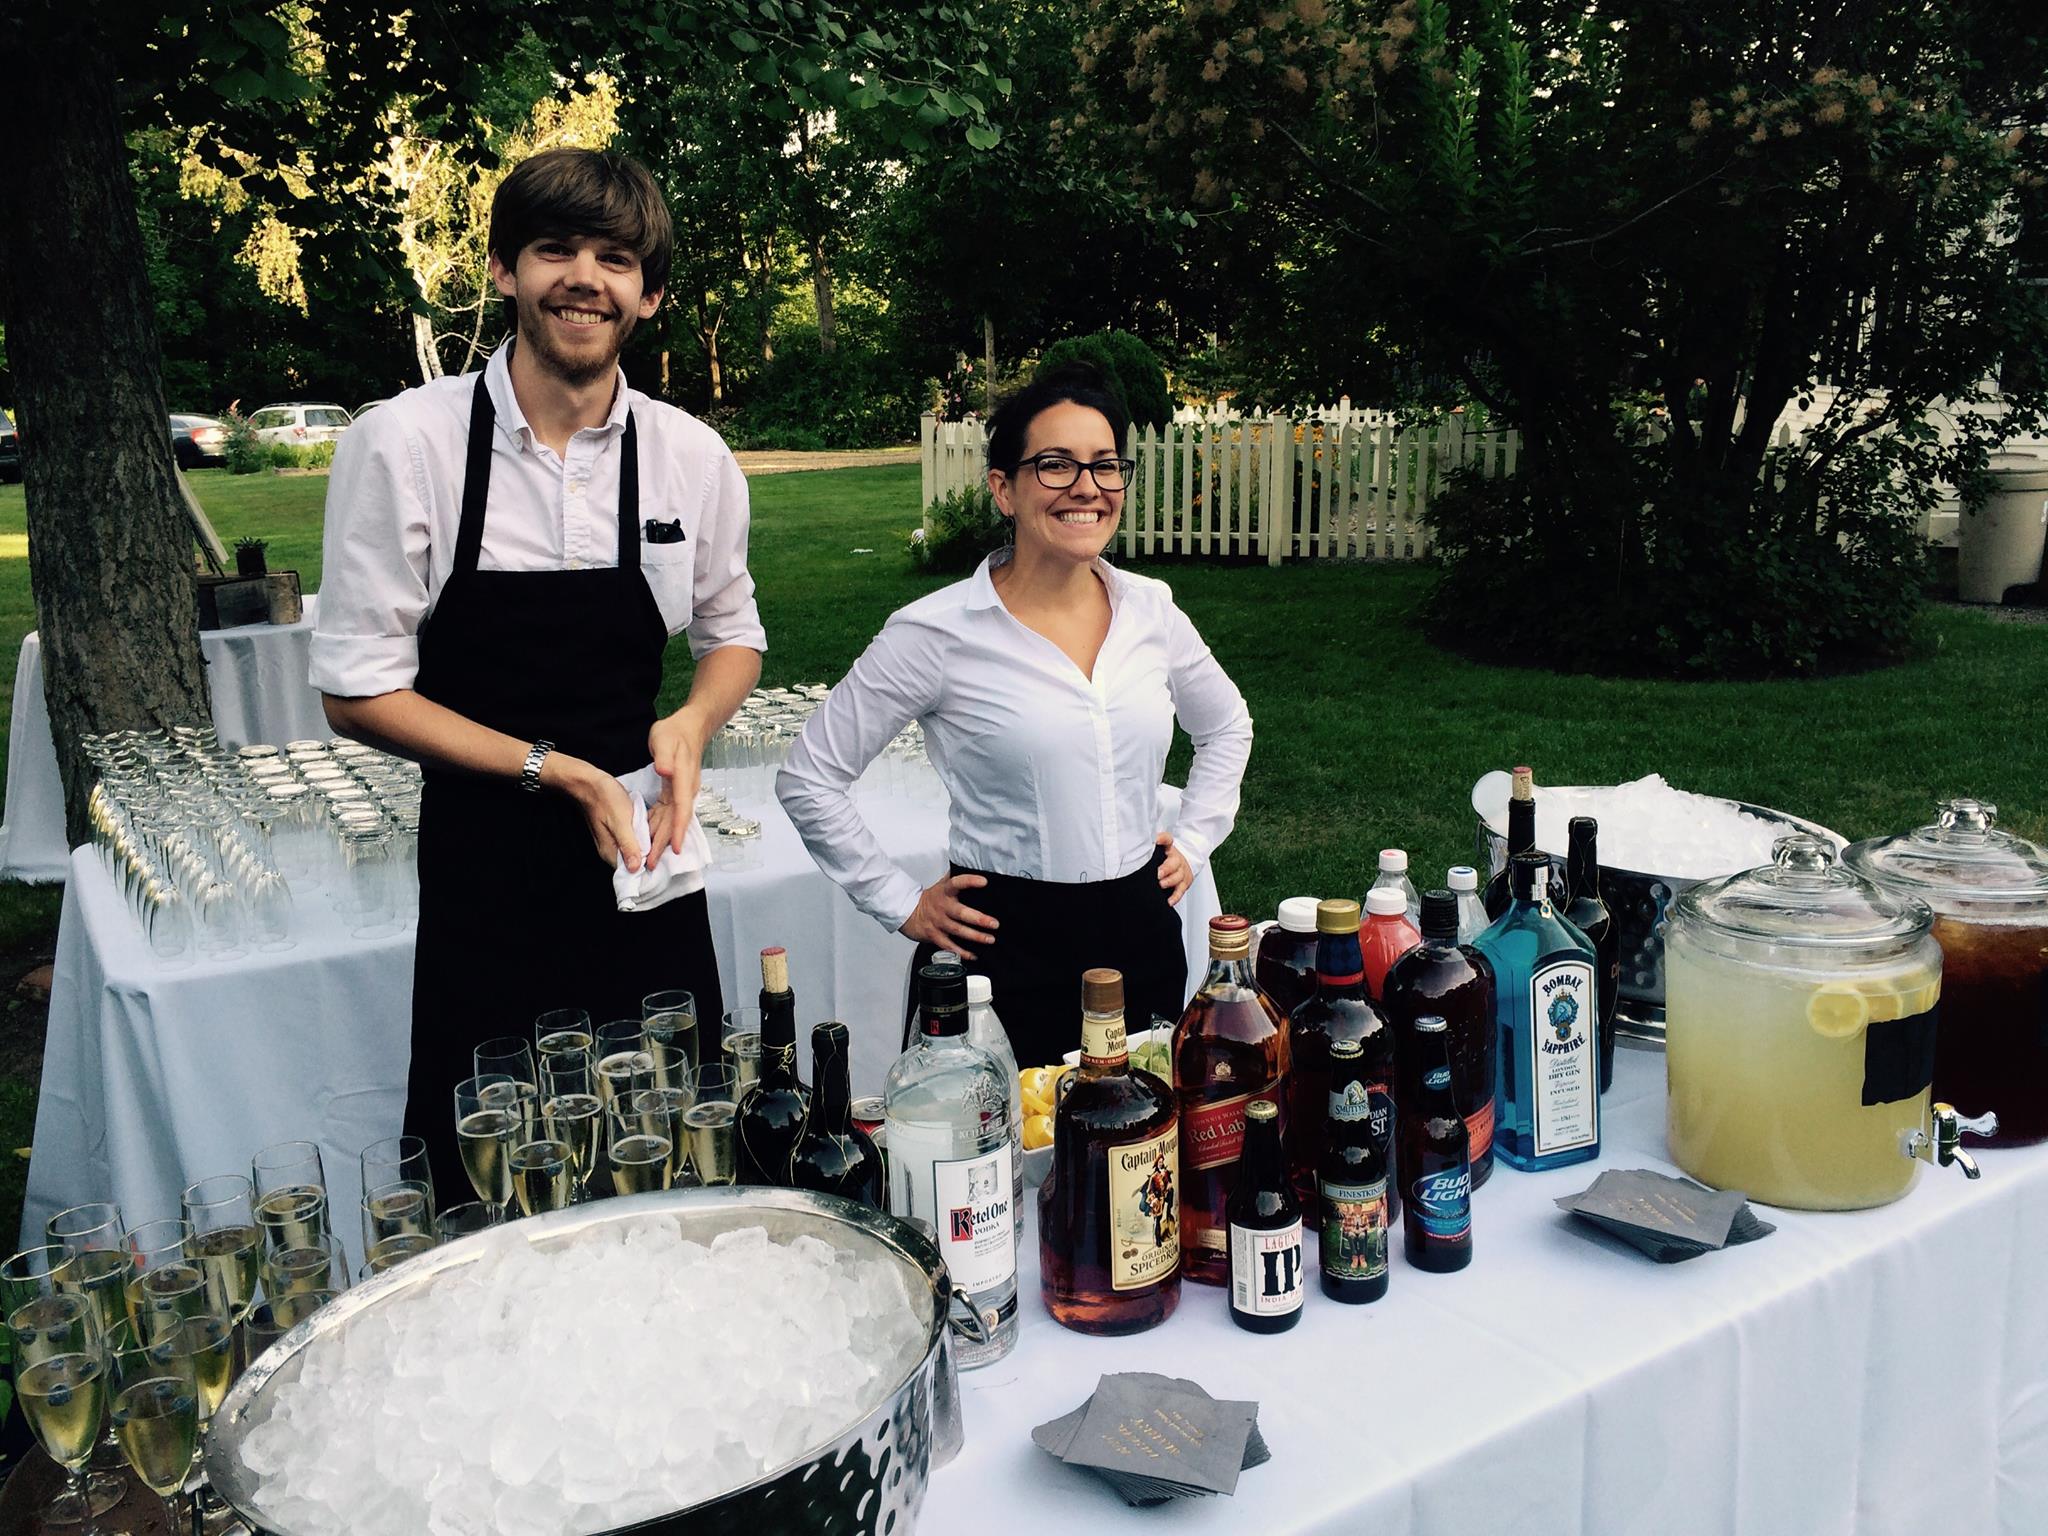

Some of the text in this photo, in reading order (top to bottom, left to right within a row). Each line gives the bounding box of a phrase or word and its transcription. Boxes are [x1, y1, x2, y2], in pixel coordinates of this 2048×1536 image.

[1542, 974, 1583, 997] BOMBAY
[1541, 1032, 1586, 1055] SAPPHIRE
[1565, 1068, 1581, 1078] GIN
[1222, 1108, 1244, 1119] WALKE
[1369, 1107, 1388, 1120] DIAN
[1188, 1125, 1218, 1144] Red
[1218, 1118, 1246, 1136] Lab
[1371, 1116, 1388, 1136] ST
[1121, 1147, 1157, 1172] Captain
[1431, 1172, 1469, 1190] BUD
[951, 1201, 1008, 1239] Ketel One
[974, 1221, 1000, 1236] VODKA
[1265, 1227, 1301, 1250] LAGUNI
[1141, 1239, 1175, 1261] ORIGINAL
[1130, 1253, 1167, 1276] SPICED
[1260, 1244, 1303, 1296] IP
[1261, 1294, 1287, 1304] INDIA
